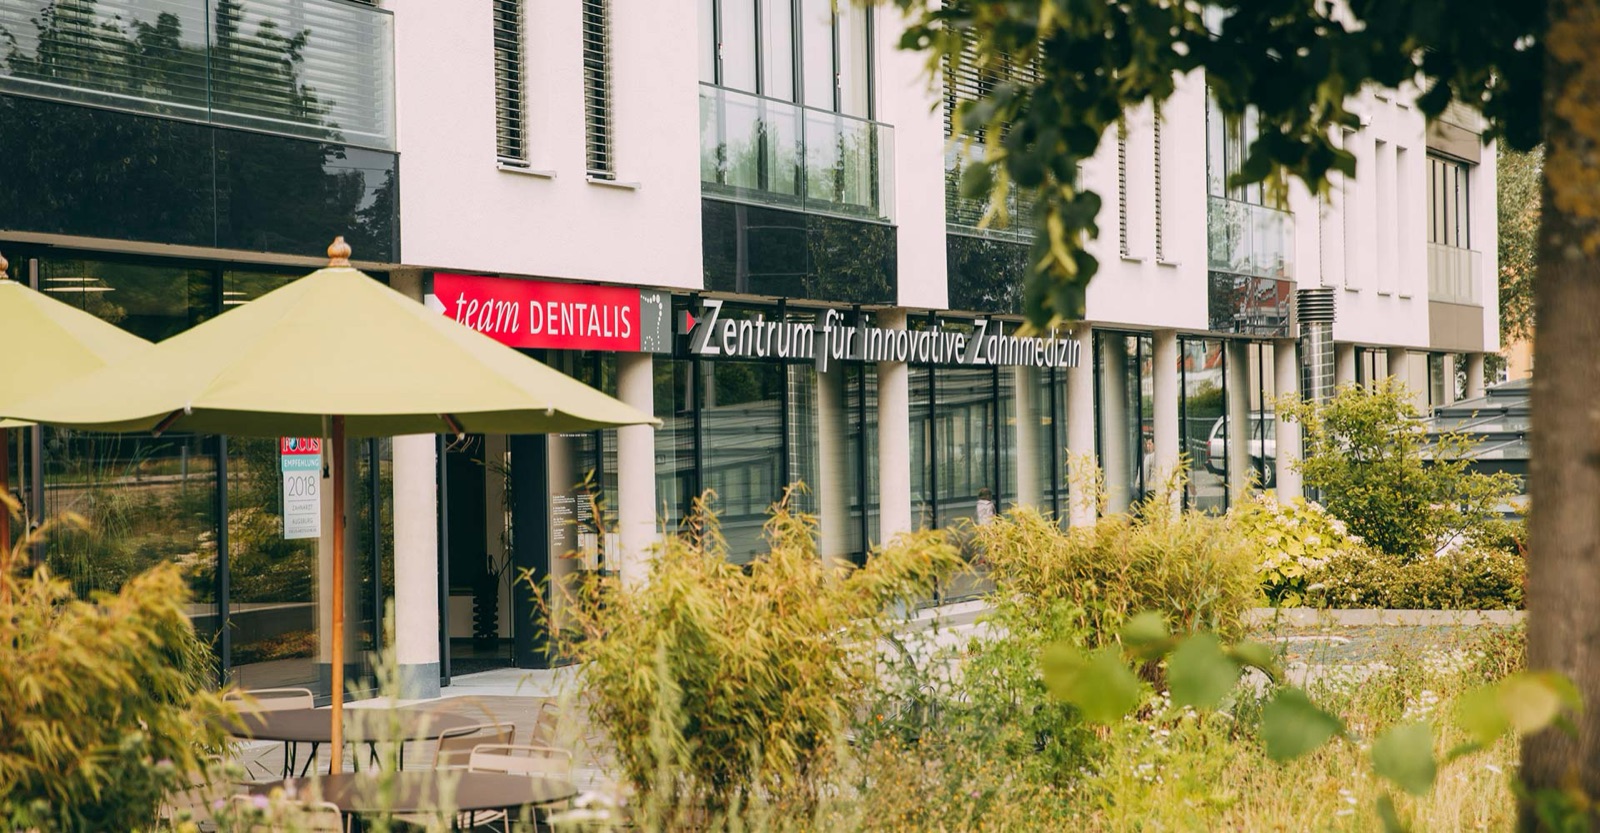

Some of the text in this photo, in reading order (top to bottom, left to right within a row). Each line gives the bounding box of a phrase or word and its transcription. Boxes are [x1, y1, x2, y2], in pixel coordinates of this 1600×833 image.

[456, 292, 631, 339] team DENTALIS
[699, 299, 1082, 373] Zentrum für innovative Zahnmedizin
[282, 437, 320, 452] FOCUS
[284, 458, 319, 468] EMPFEHLUNG
[288, 475, 316, 497] 2018
